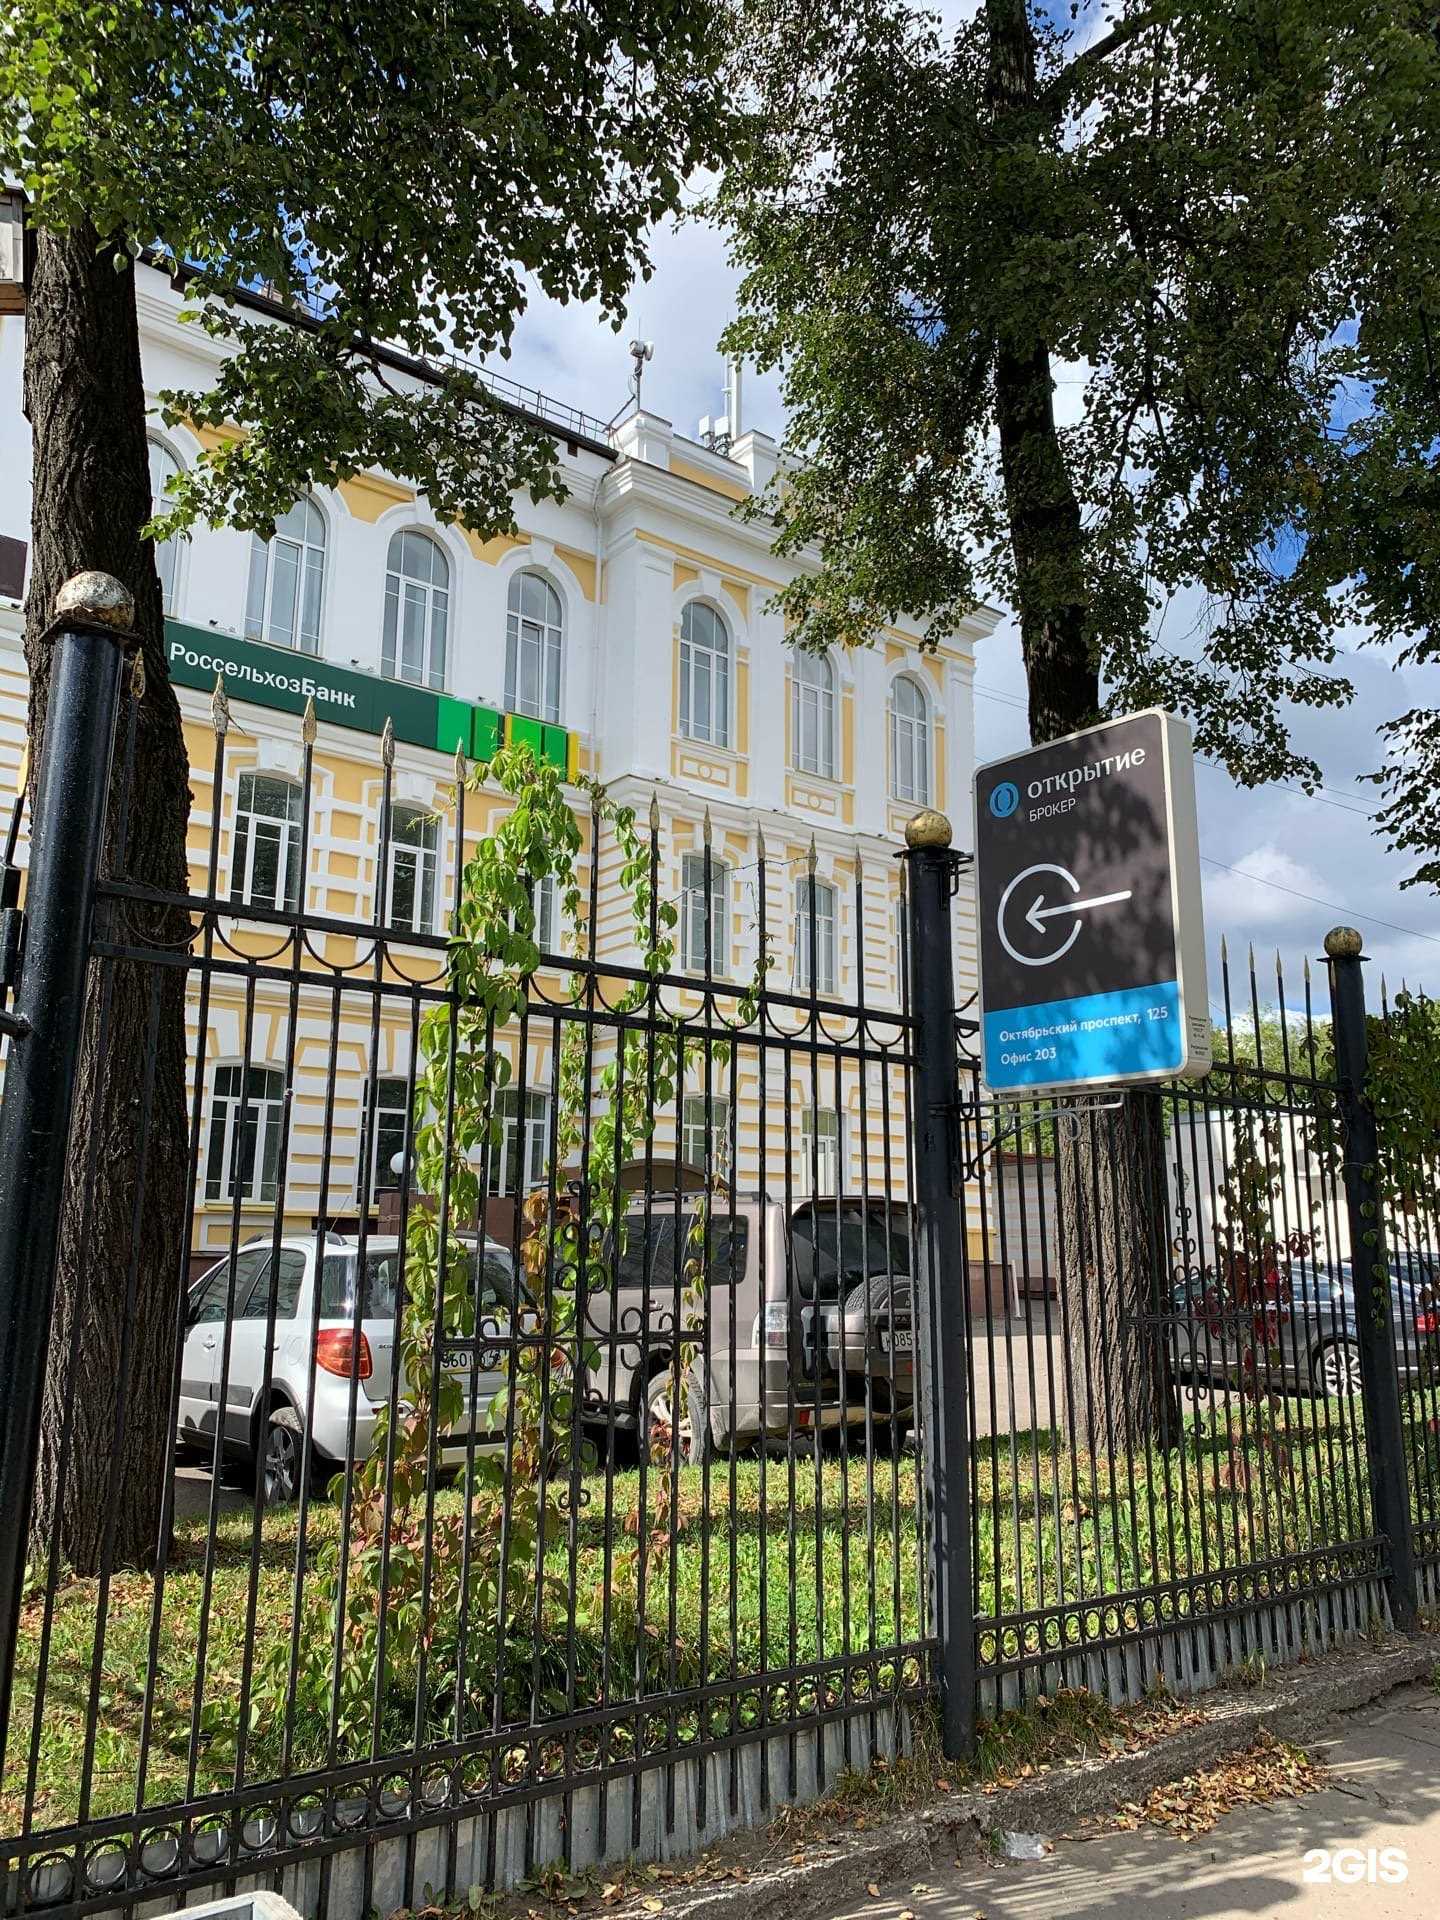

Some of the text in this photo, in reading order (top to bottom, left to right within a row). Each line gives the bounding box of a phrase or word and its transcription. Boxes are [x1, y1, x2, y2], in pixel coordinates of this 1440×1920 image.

[169, 642, 357, 709] РоссельхозБанк
[1027, 748, 1146, 799] открытие
[1029, 797, 1076, 822] БРОКЕР
[999, 1006, 1168, 1042] Октябрьский проспект, 125
[1000, 1046, 1057, 1066] Офис 203
